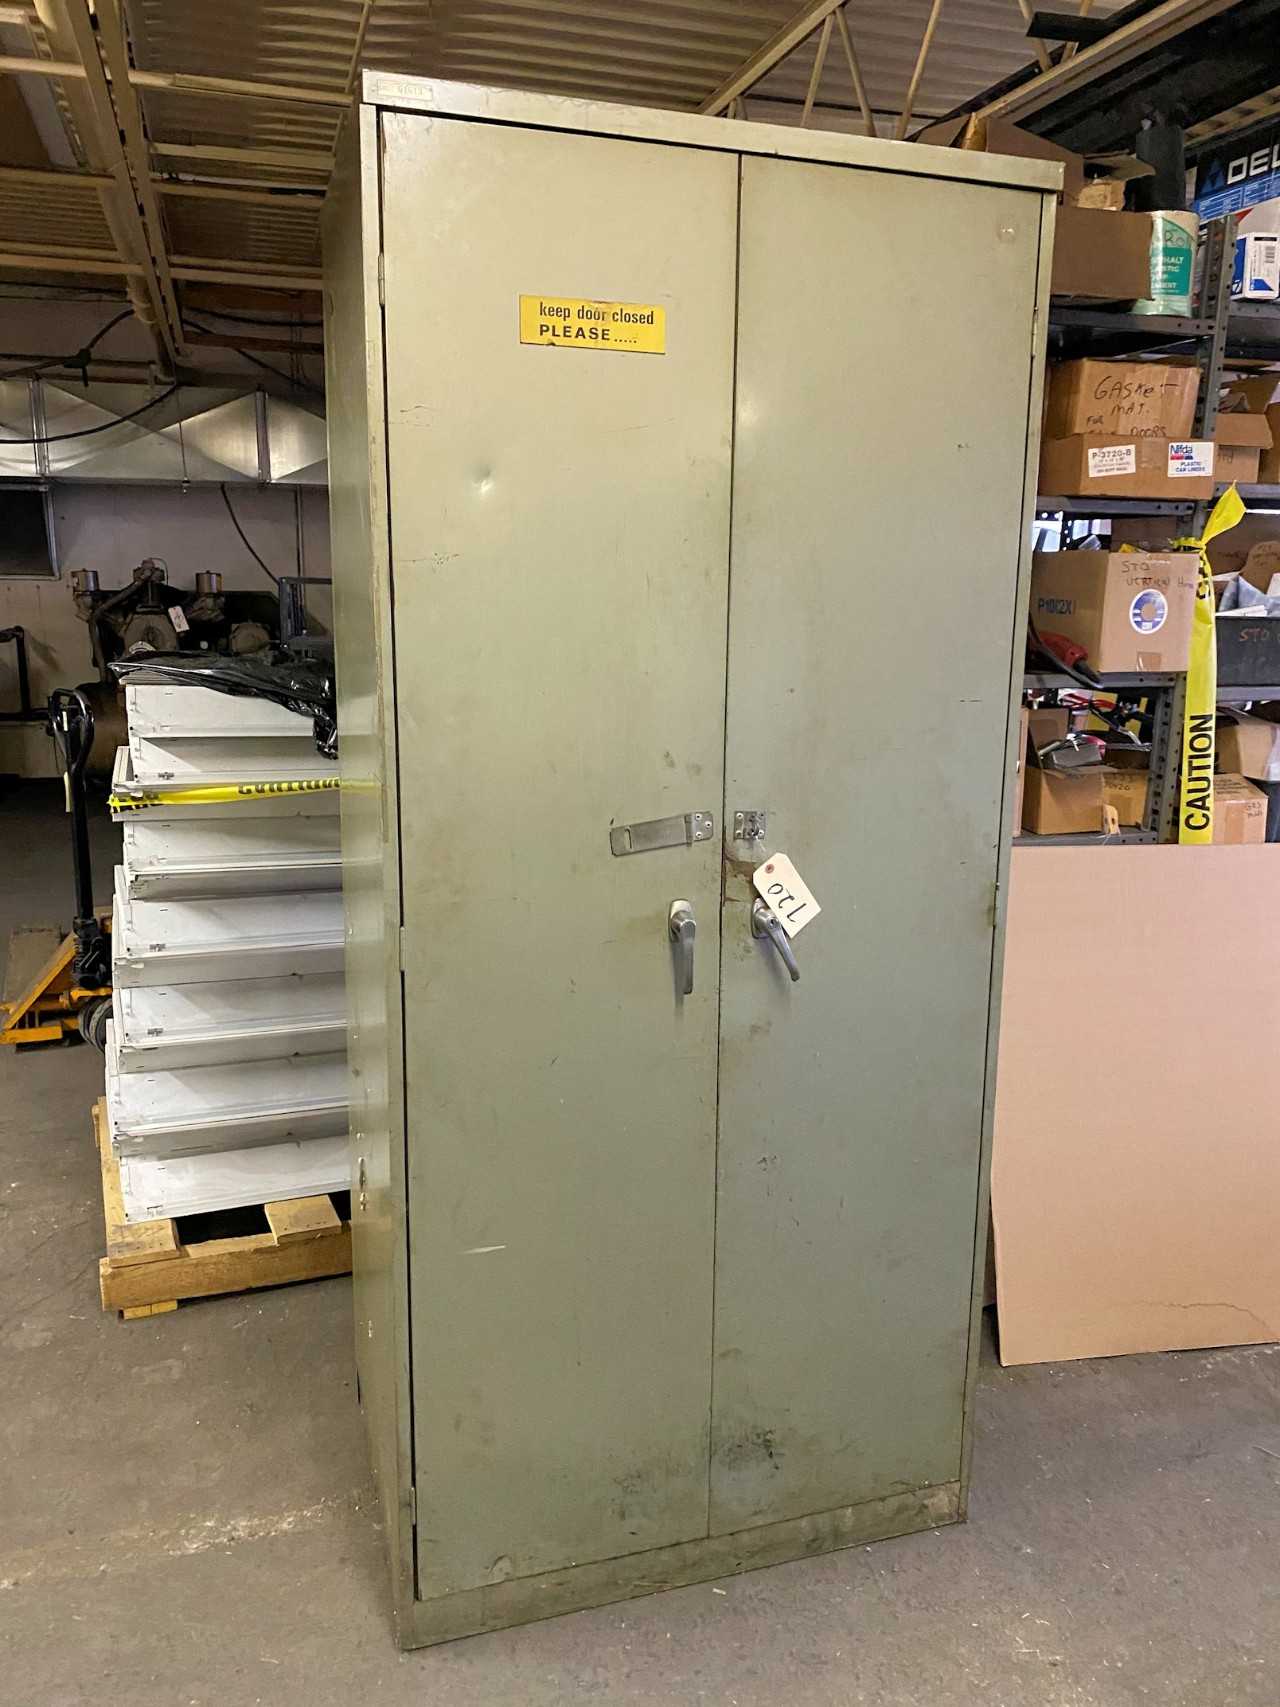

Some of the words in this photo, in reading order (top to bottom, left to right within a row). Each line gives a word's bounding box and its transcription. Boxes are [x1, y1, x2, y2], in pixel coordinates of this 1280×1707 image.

[539, 301, 571, 321] keep
[577, 305, 606, 321] door
[612, 307, 654, 325] closed
[1184, 714, 1213, 831] CAUTION
[767, 883, 807, 923] 120
